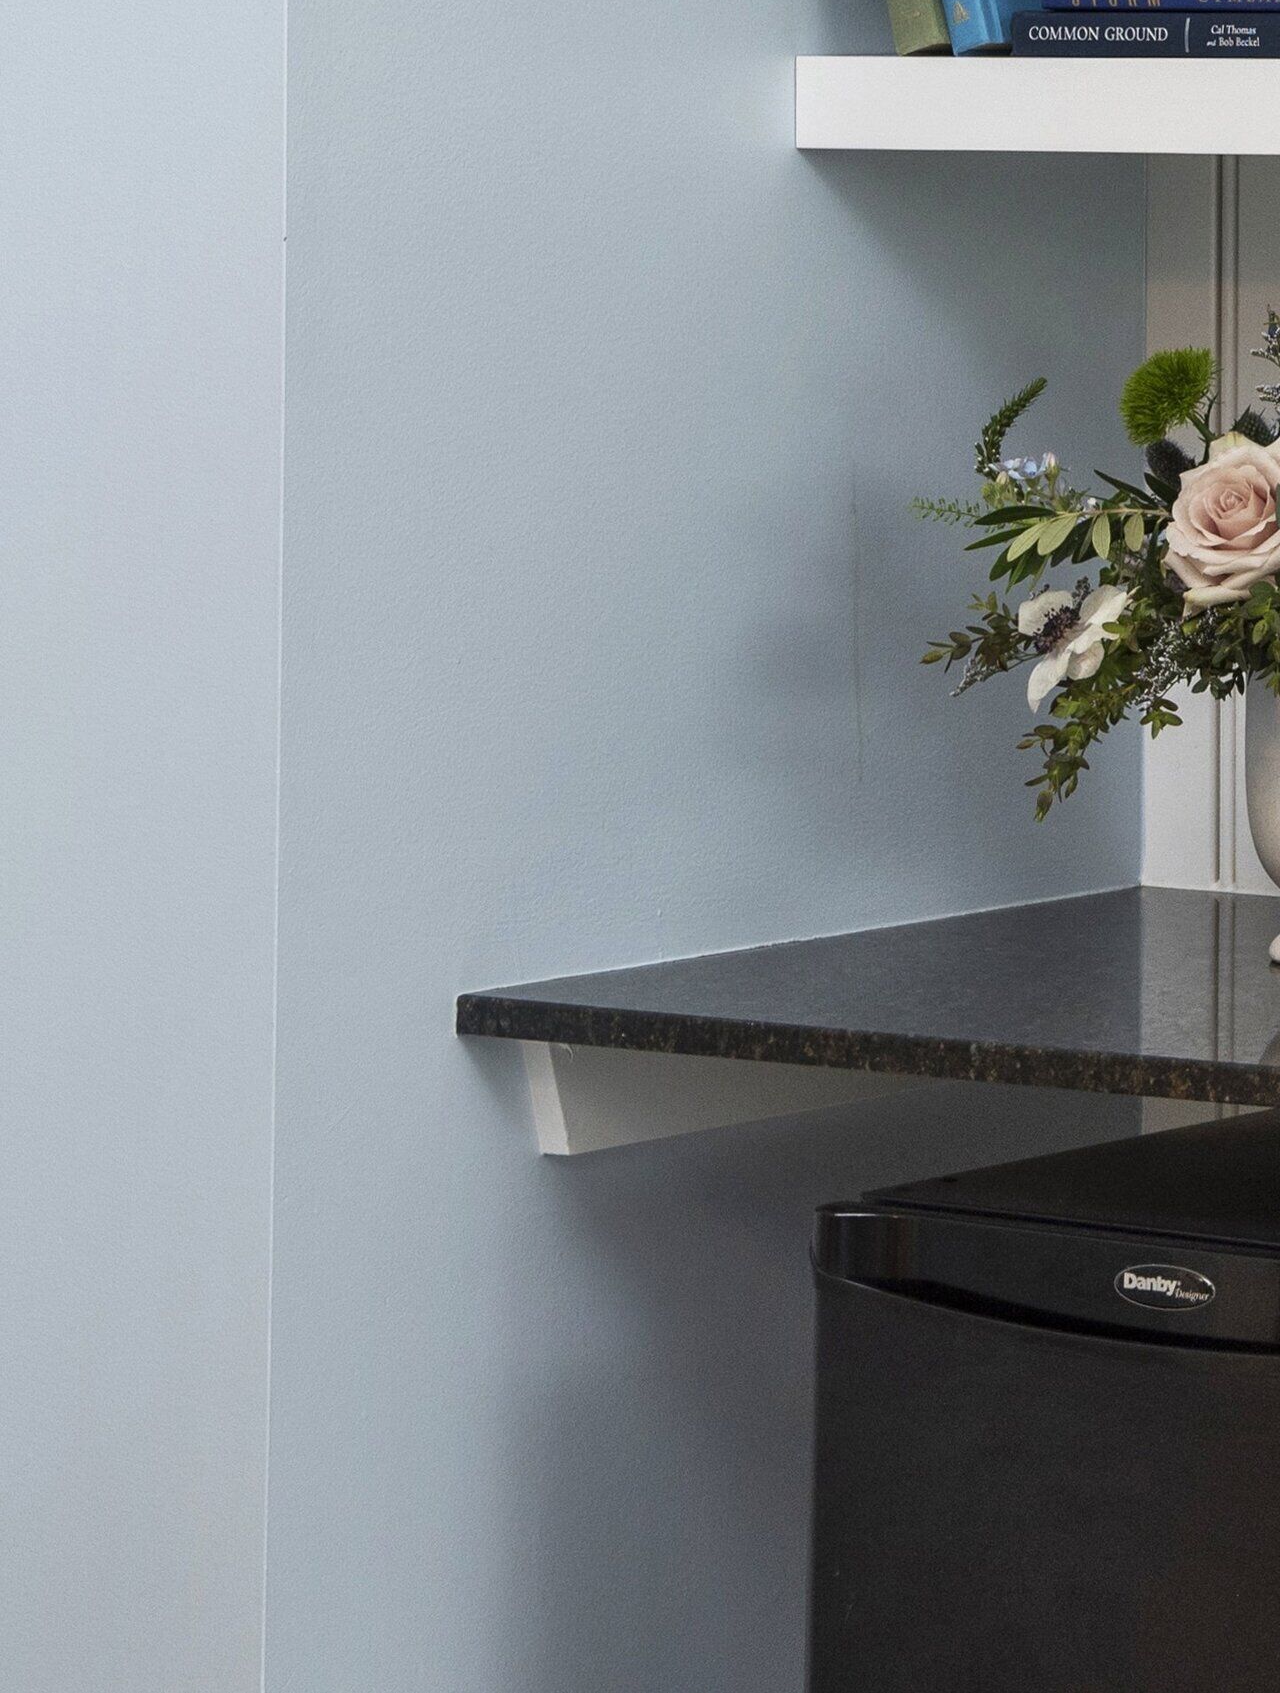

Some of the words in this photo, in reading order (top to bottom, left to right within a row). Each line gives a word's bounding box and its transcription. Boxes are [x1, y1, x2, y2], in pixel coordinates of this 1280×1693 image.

[1029, 26, 1100, 41] COMMON
[1104, 26, 1168, 41] GROUND
[1211, 24, 1224, 35] Cal
[1225, 24, 1257, 35] Thomas
[1218, 36, 1234, 47] Bob
[1235, 36, 1260, 48] Beckel
[1123, 1271, 1177, 1296] Danby
[1175, 1287, 1210, 1304] Designer
